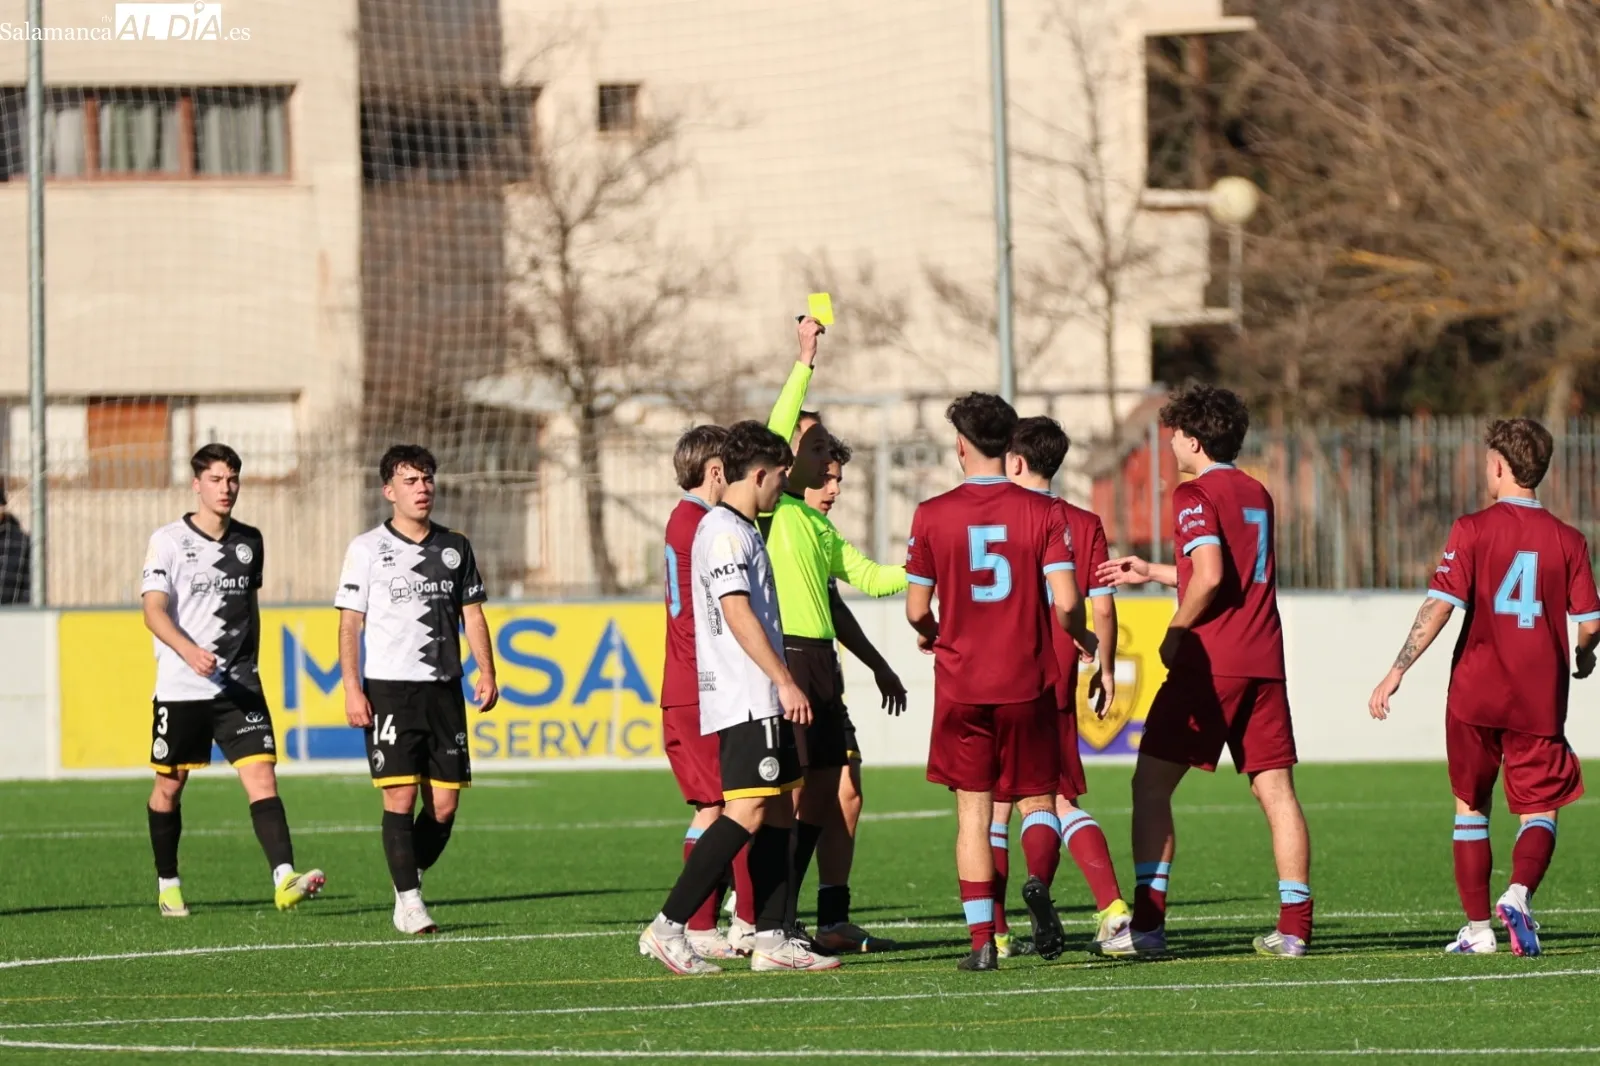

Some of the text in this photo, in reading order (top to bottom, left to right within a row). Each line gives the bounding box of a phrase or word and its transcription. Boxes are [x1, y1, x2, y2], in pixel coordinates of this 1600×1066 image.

[967, 524, 1012, 602] 5
[1242, 507, 1268, 583] 7
[215, 574, 236, 588] Don
[415, 581, 438, 593] Don
[1494, 550, 1543, 628] 4
[281, 617, 656, 708] MSA
[157, 706, 168, 735] 3
[373, 714, 397, 745] 14
[474, 719, 666, 758] SERVIC
